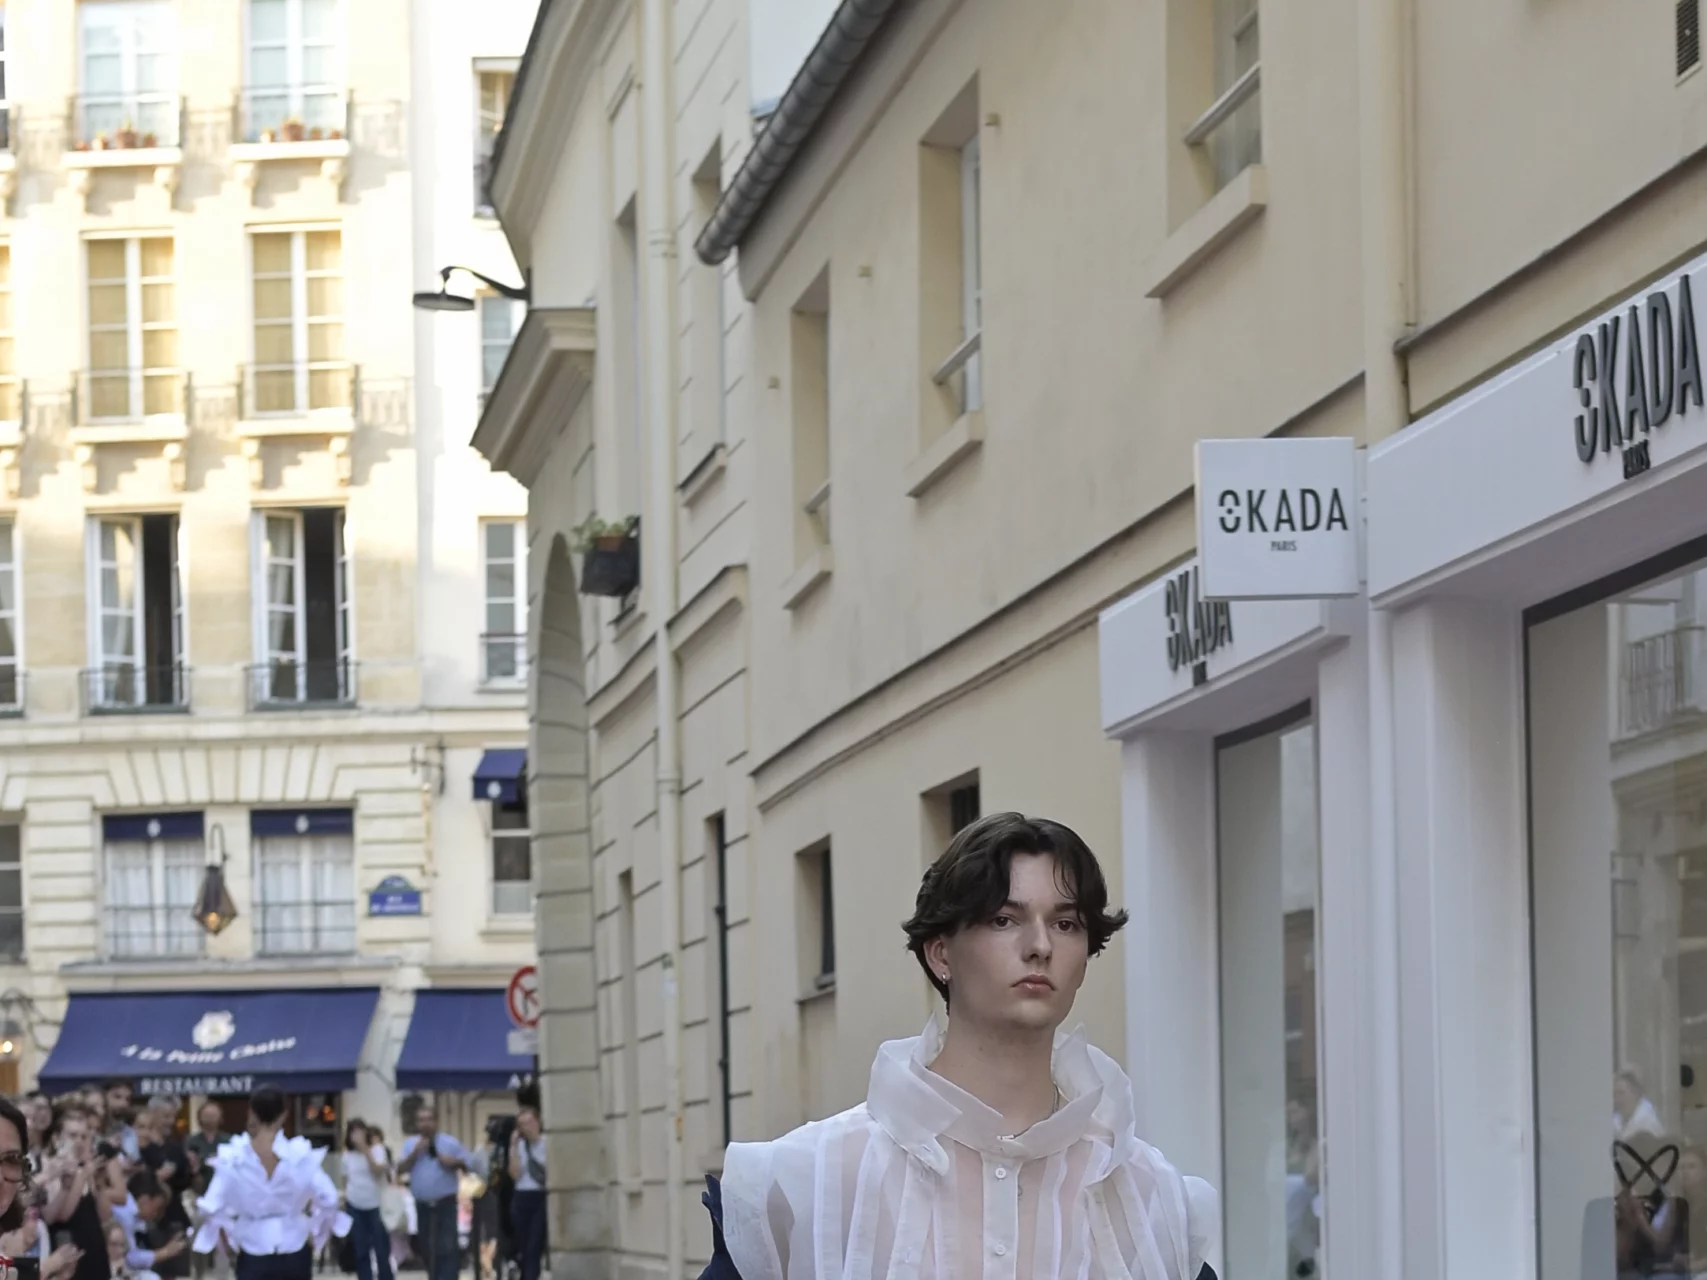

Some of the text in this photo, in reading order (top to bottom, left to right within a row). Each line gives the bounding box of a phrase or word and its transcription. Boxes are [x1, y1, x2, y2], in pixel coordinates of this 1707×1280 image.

[1218, 487, 1349, 534] OKADA
[1270, 540, 1298, 552] PARIS
[140, 1074, 254, 1095] RESTAURANT
